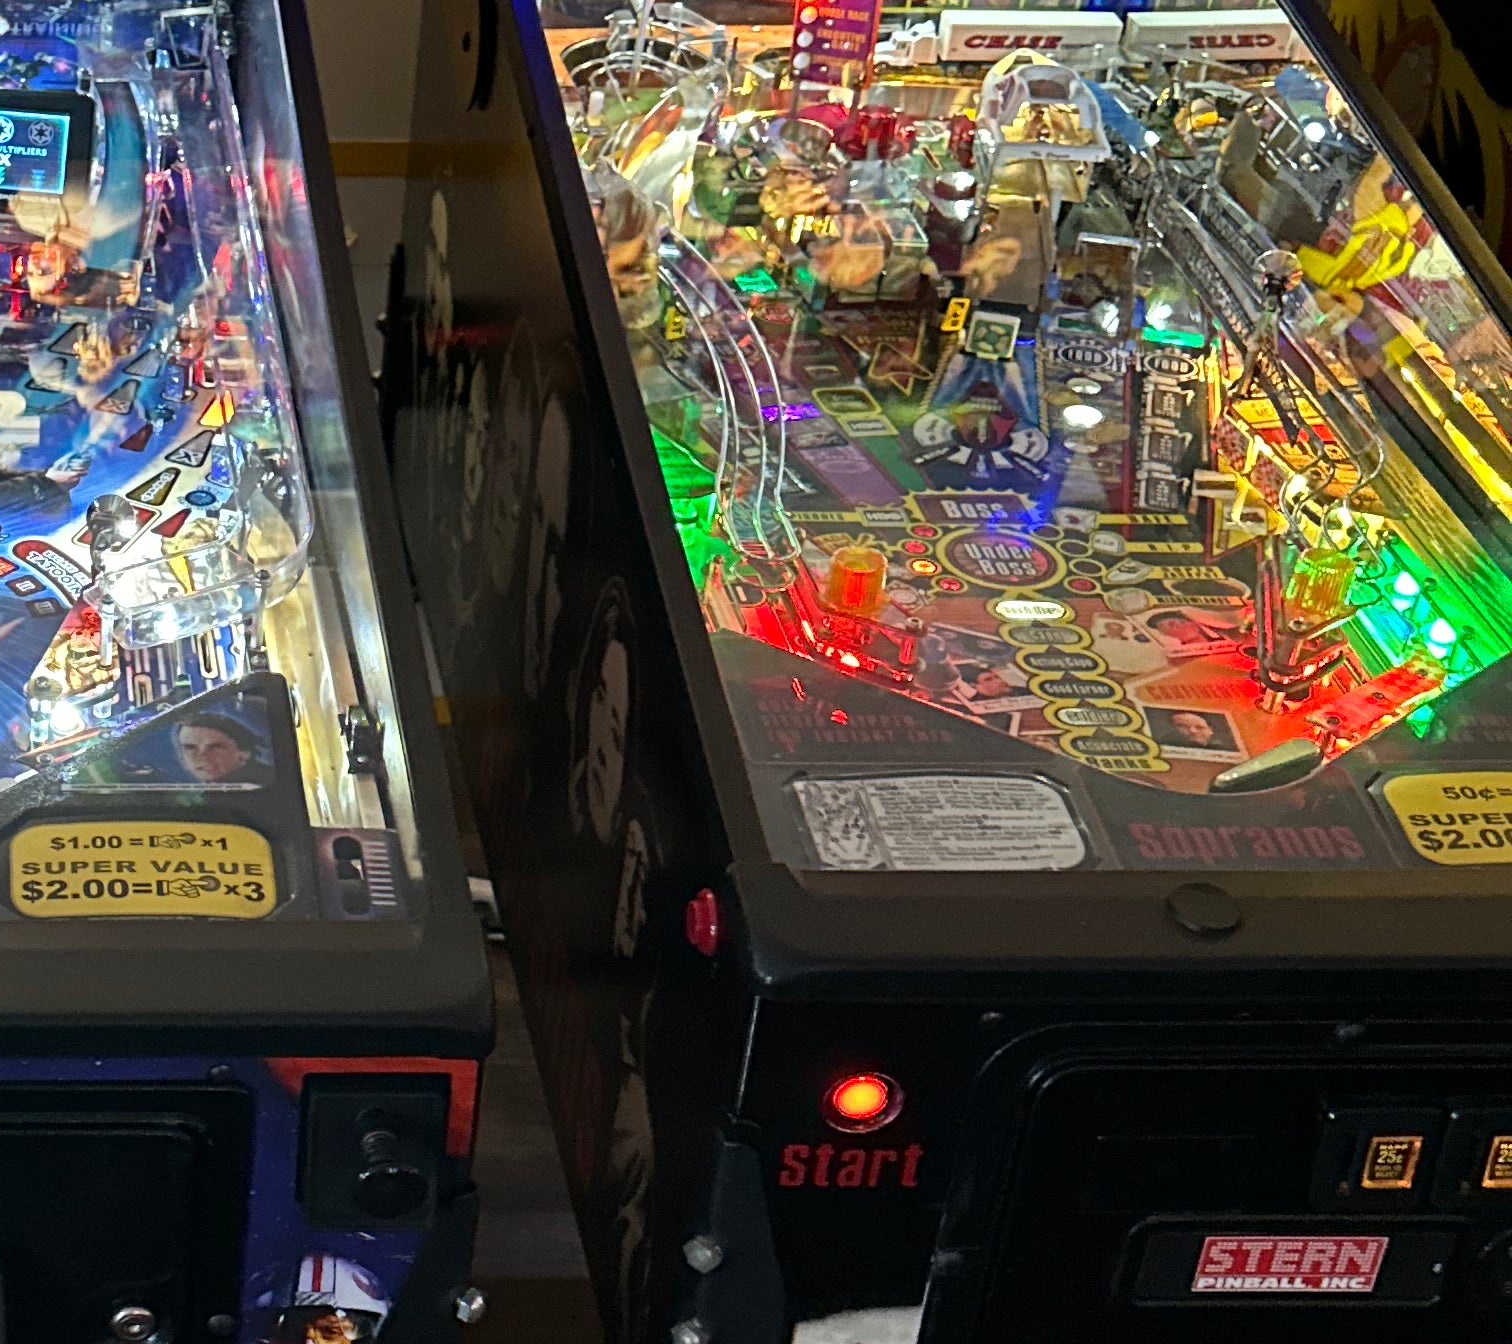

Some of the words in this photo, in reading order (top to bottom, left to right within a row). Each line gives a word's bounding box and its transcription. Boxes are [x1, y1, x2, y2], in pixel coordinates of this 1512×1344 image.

[1155, 356, 1191, 373] FOOD
[944, 499, 1009, 520] Boss
[964, 541, 1035, 560] Under
[979, 557, 1037, 576] Boss
[1043, 683, 1073, 694] Good
[50, 834, 122, 851] $1.00
[201, 836, 228, 851] x1
[1128, 823, 1364, 864] Sopranos
[21, 860, 136, 875] SUPER
[150, 860, 264, 877] VALUE
[223, 881, 266, 902] x3
[1204, 1241, 1378, 1273] STERN
